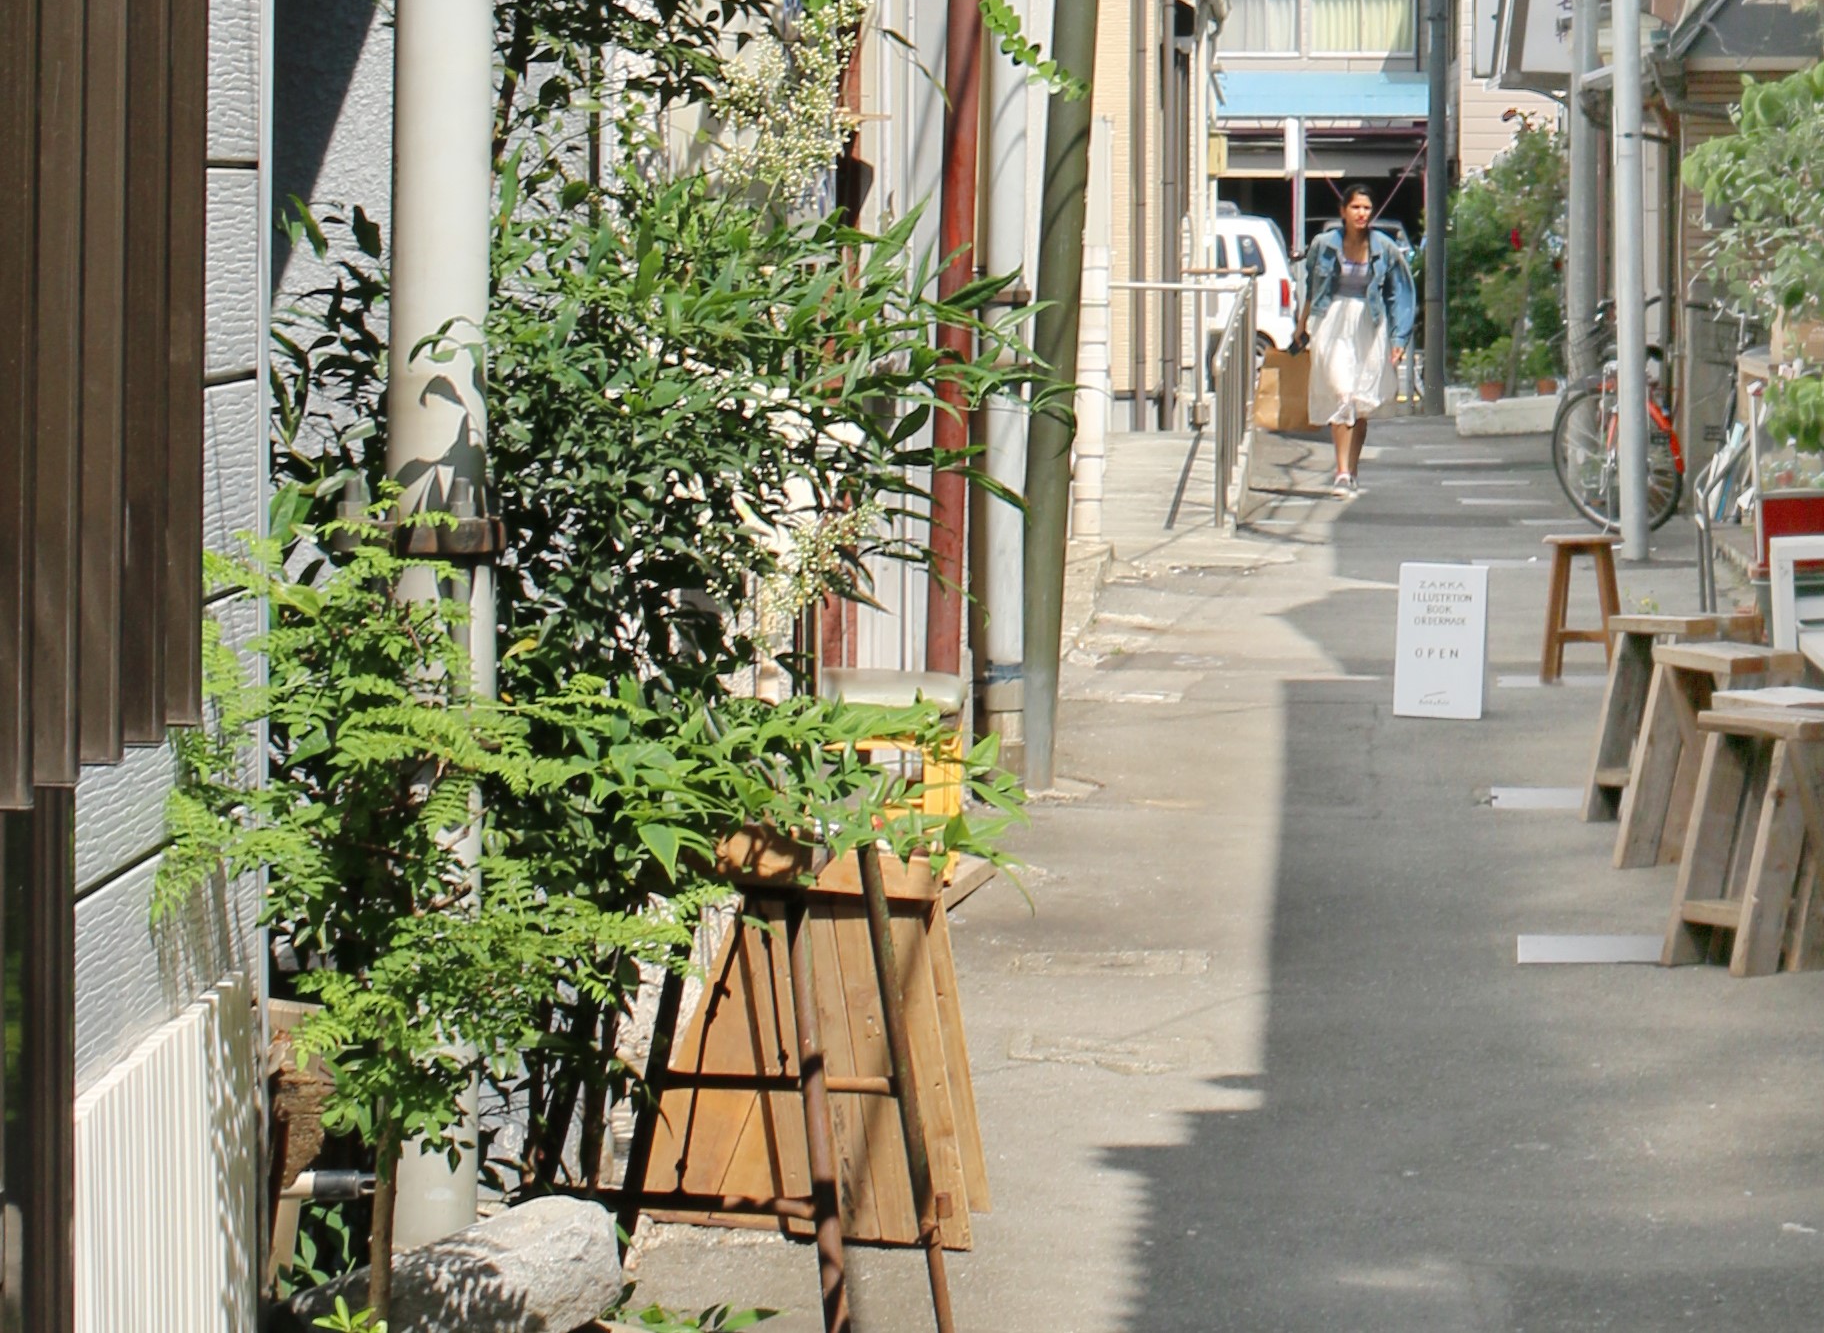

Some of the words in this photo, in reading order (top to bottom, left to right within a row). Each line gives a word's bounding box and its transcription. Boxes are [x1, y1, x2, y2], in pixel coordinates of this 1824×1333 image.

[1418, 580, 1466, 590] ZAKKA
[1426, 604, 1453, 615] BOOK
[1414, 647, 1460, 659] OPEN
